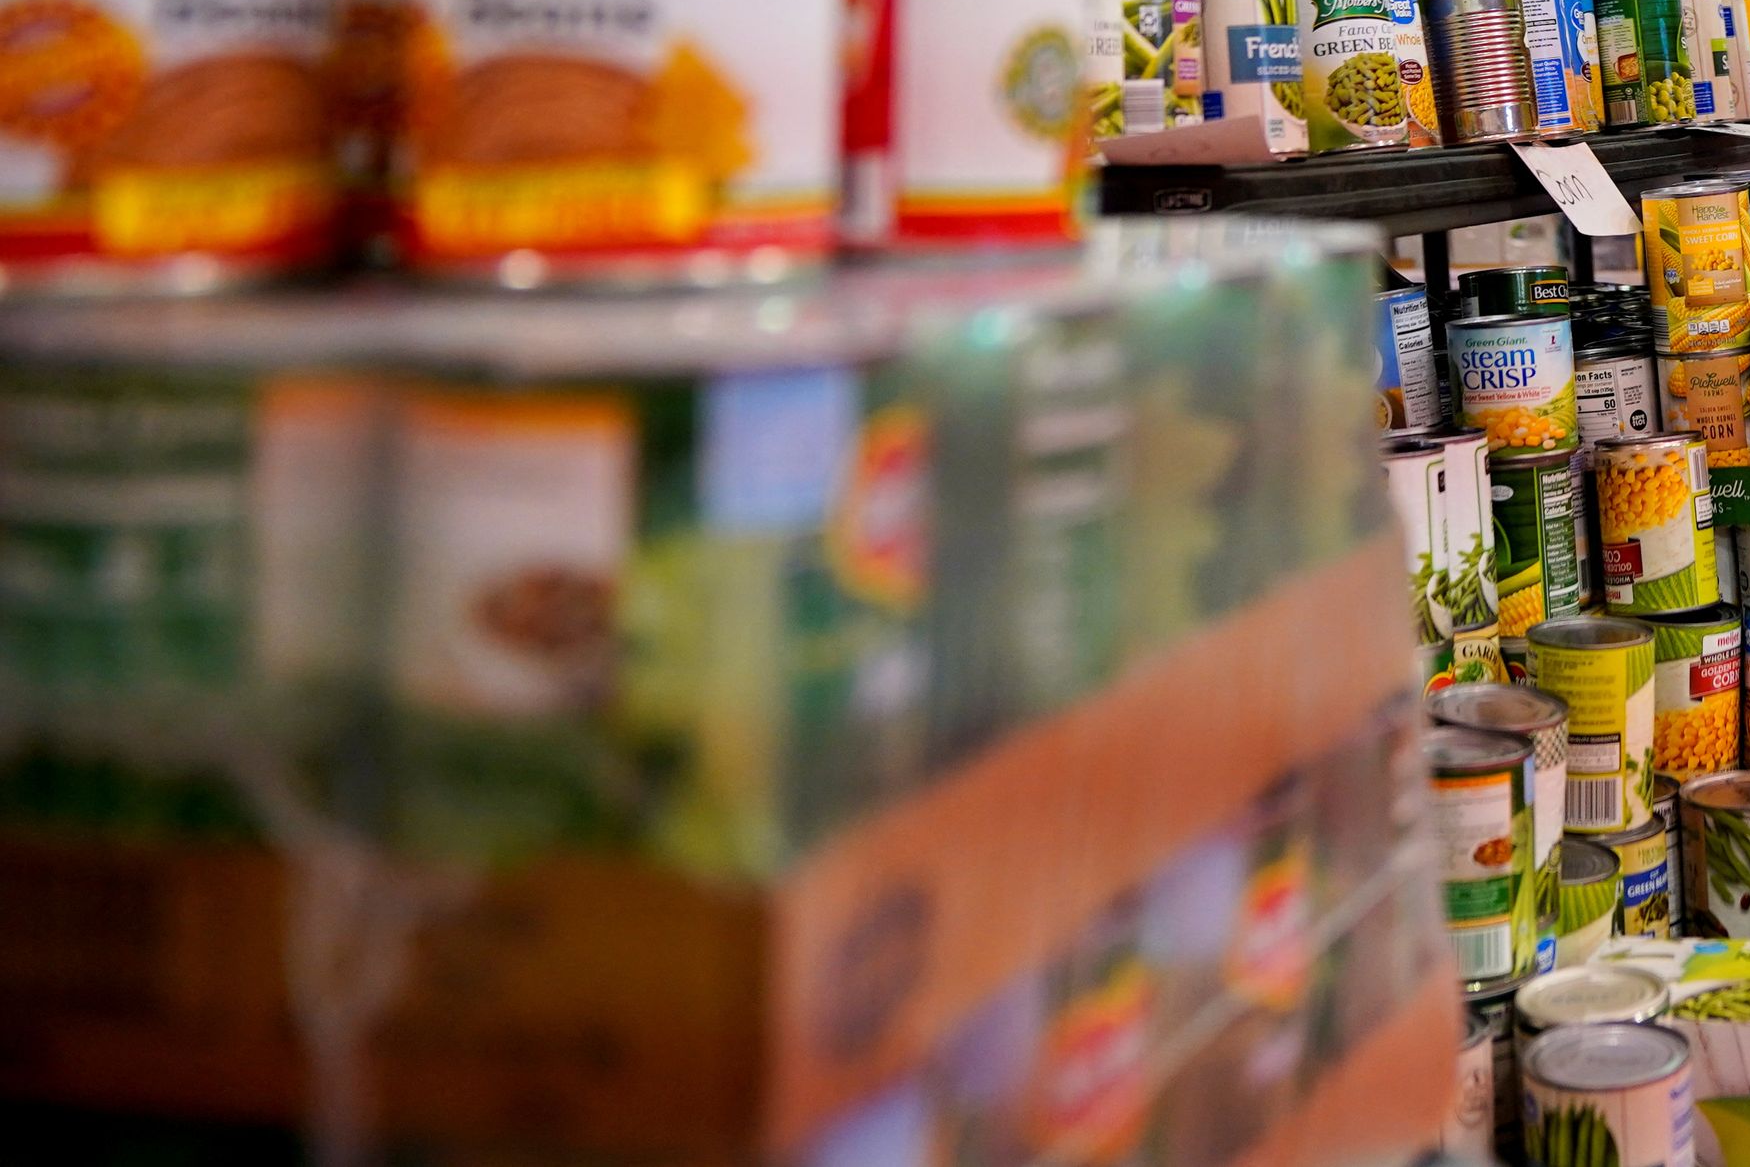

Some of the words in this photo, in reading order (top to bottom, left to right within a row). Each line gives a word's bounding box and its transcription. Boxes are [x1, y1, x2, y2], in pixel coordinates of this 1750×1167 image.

[1390, 0, 1411, 11] Great
[1338, 23, 1379, 38] Fancy
[1397, 33, 1422, 45] Whole
[1246, 37, 1299, 60] Frenc
[1313, 38, 1375, 57] GREEN
[1537, 168, 1594, 206] Corn
[1692, 204, 1719, 216] Happy
[1696, 211, 1730, 222] Harvest
[1685, 235, 1714, 245] SWEET
[1716, 232, 1738, 242] CORN
[1534, 286, 1556, 300] Best
[1393, 304, 1419, 316] Nutrition
[1399, 338, 1424, 350] Calories
[1465, 337, 1495, 348] Green
[1496, 336, 1526, 347] Giant
[1461, 347, 1536, 369] steam
[1463, 367, 1536, 390] CRISP
[1588, 370, 1613, 381] Facts
[1690, 371, 1737, 390] Pickwell
[1478, 392, 1495, 401] Sweet
[1496, 391, 1515, 401] Yellow
[1522, 389, 1540, 399] White
[1603, 398, 1616, 409] 60
[1697, 415, 1714, 424] WHOLE
[1716, 413, 1737, 423] KERNEL
[1701, 425, 1734, 440] CORN
[1703, 651, 1728, 664] WHOLE
[1701, 664, 1732, 679] GOLDEN
[1713, 670, 1740, 688] CORN
